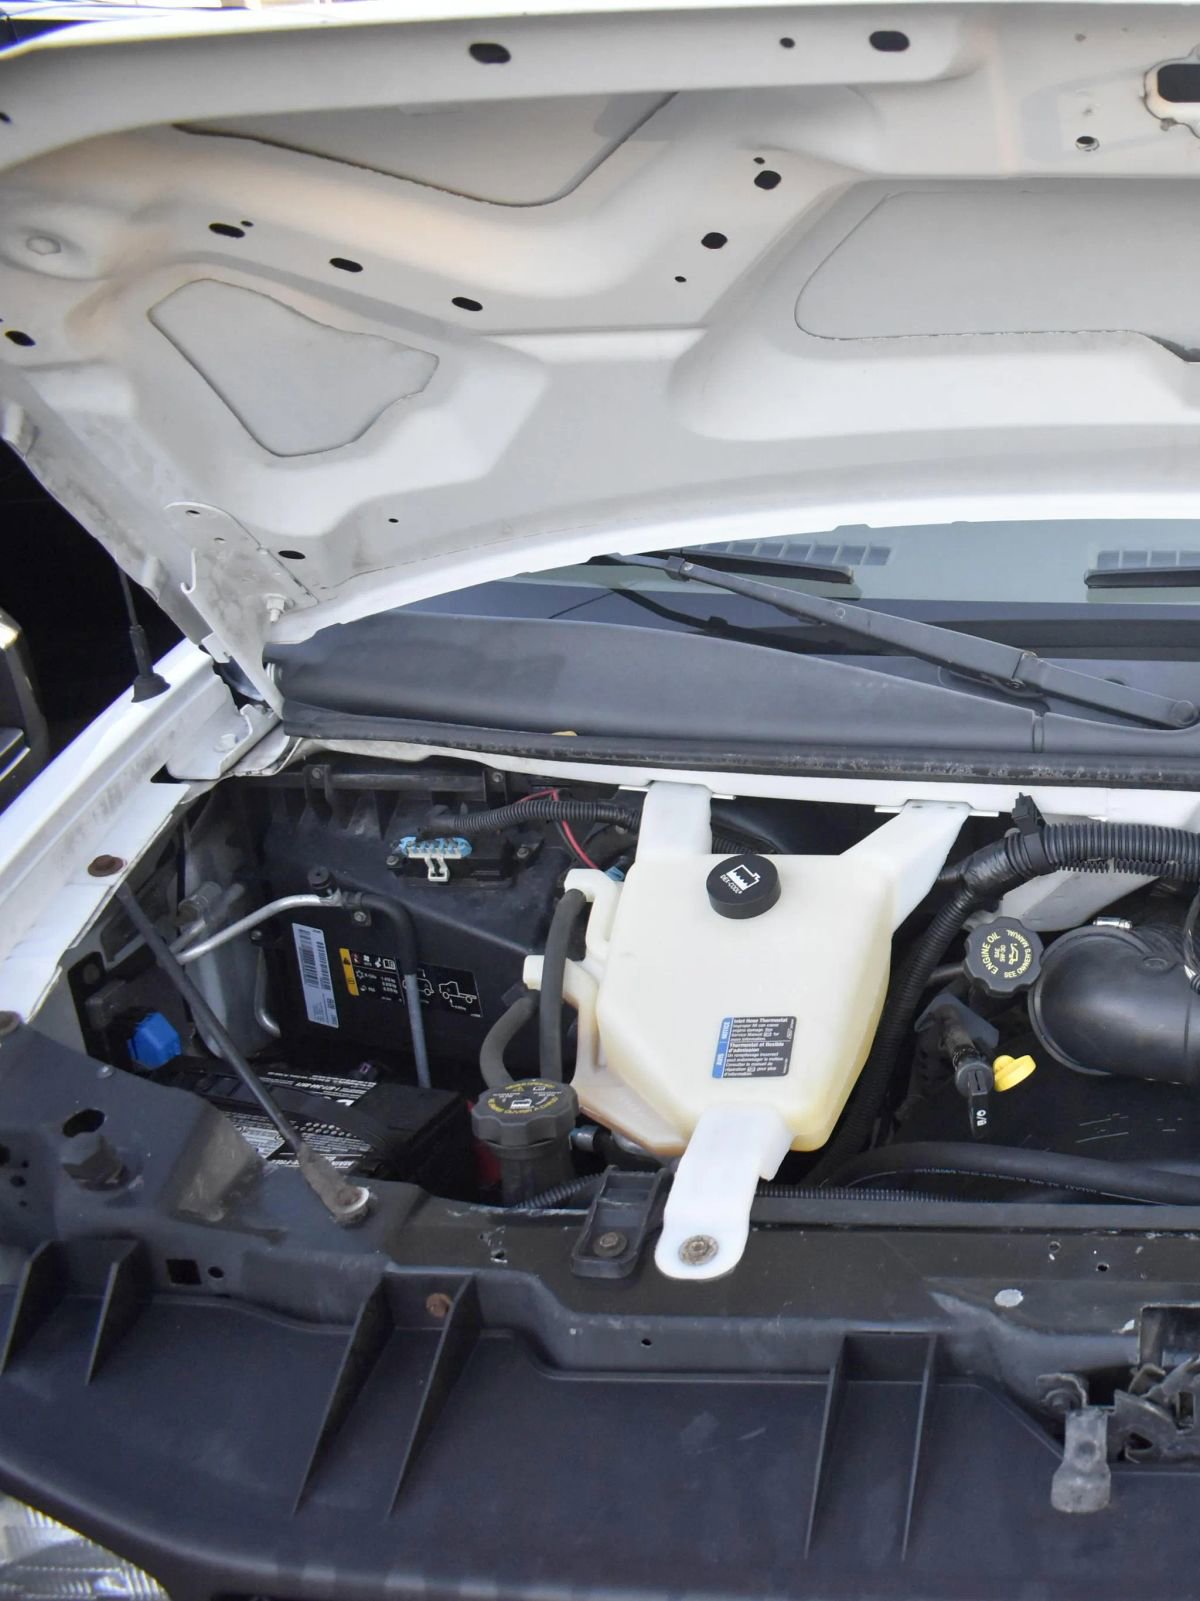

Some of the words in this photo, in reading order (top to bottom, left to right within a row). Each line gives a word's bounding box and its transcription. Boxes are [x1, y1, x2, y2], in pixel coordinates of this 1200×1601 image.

[986, 932, 1001, 943] OIL
[1006, 929, 1029, 948] MANUAL
[980, 942, 999, 975] ENGINE
[1004, 970, 1017, 979] SEE
